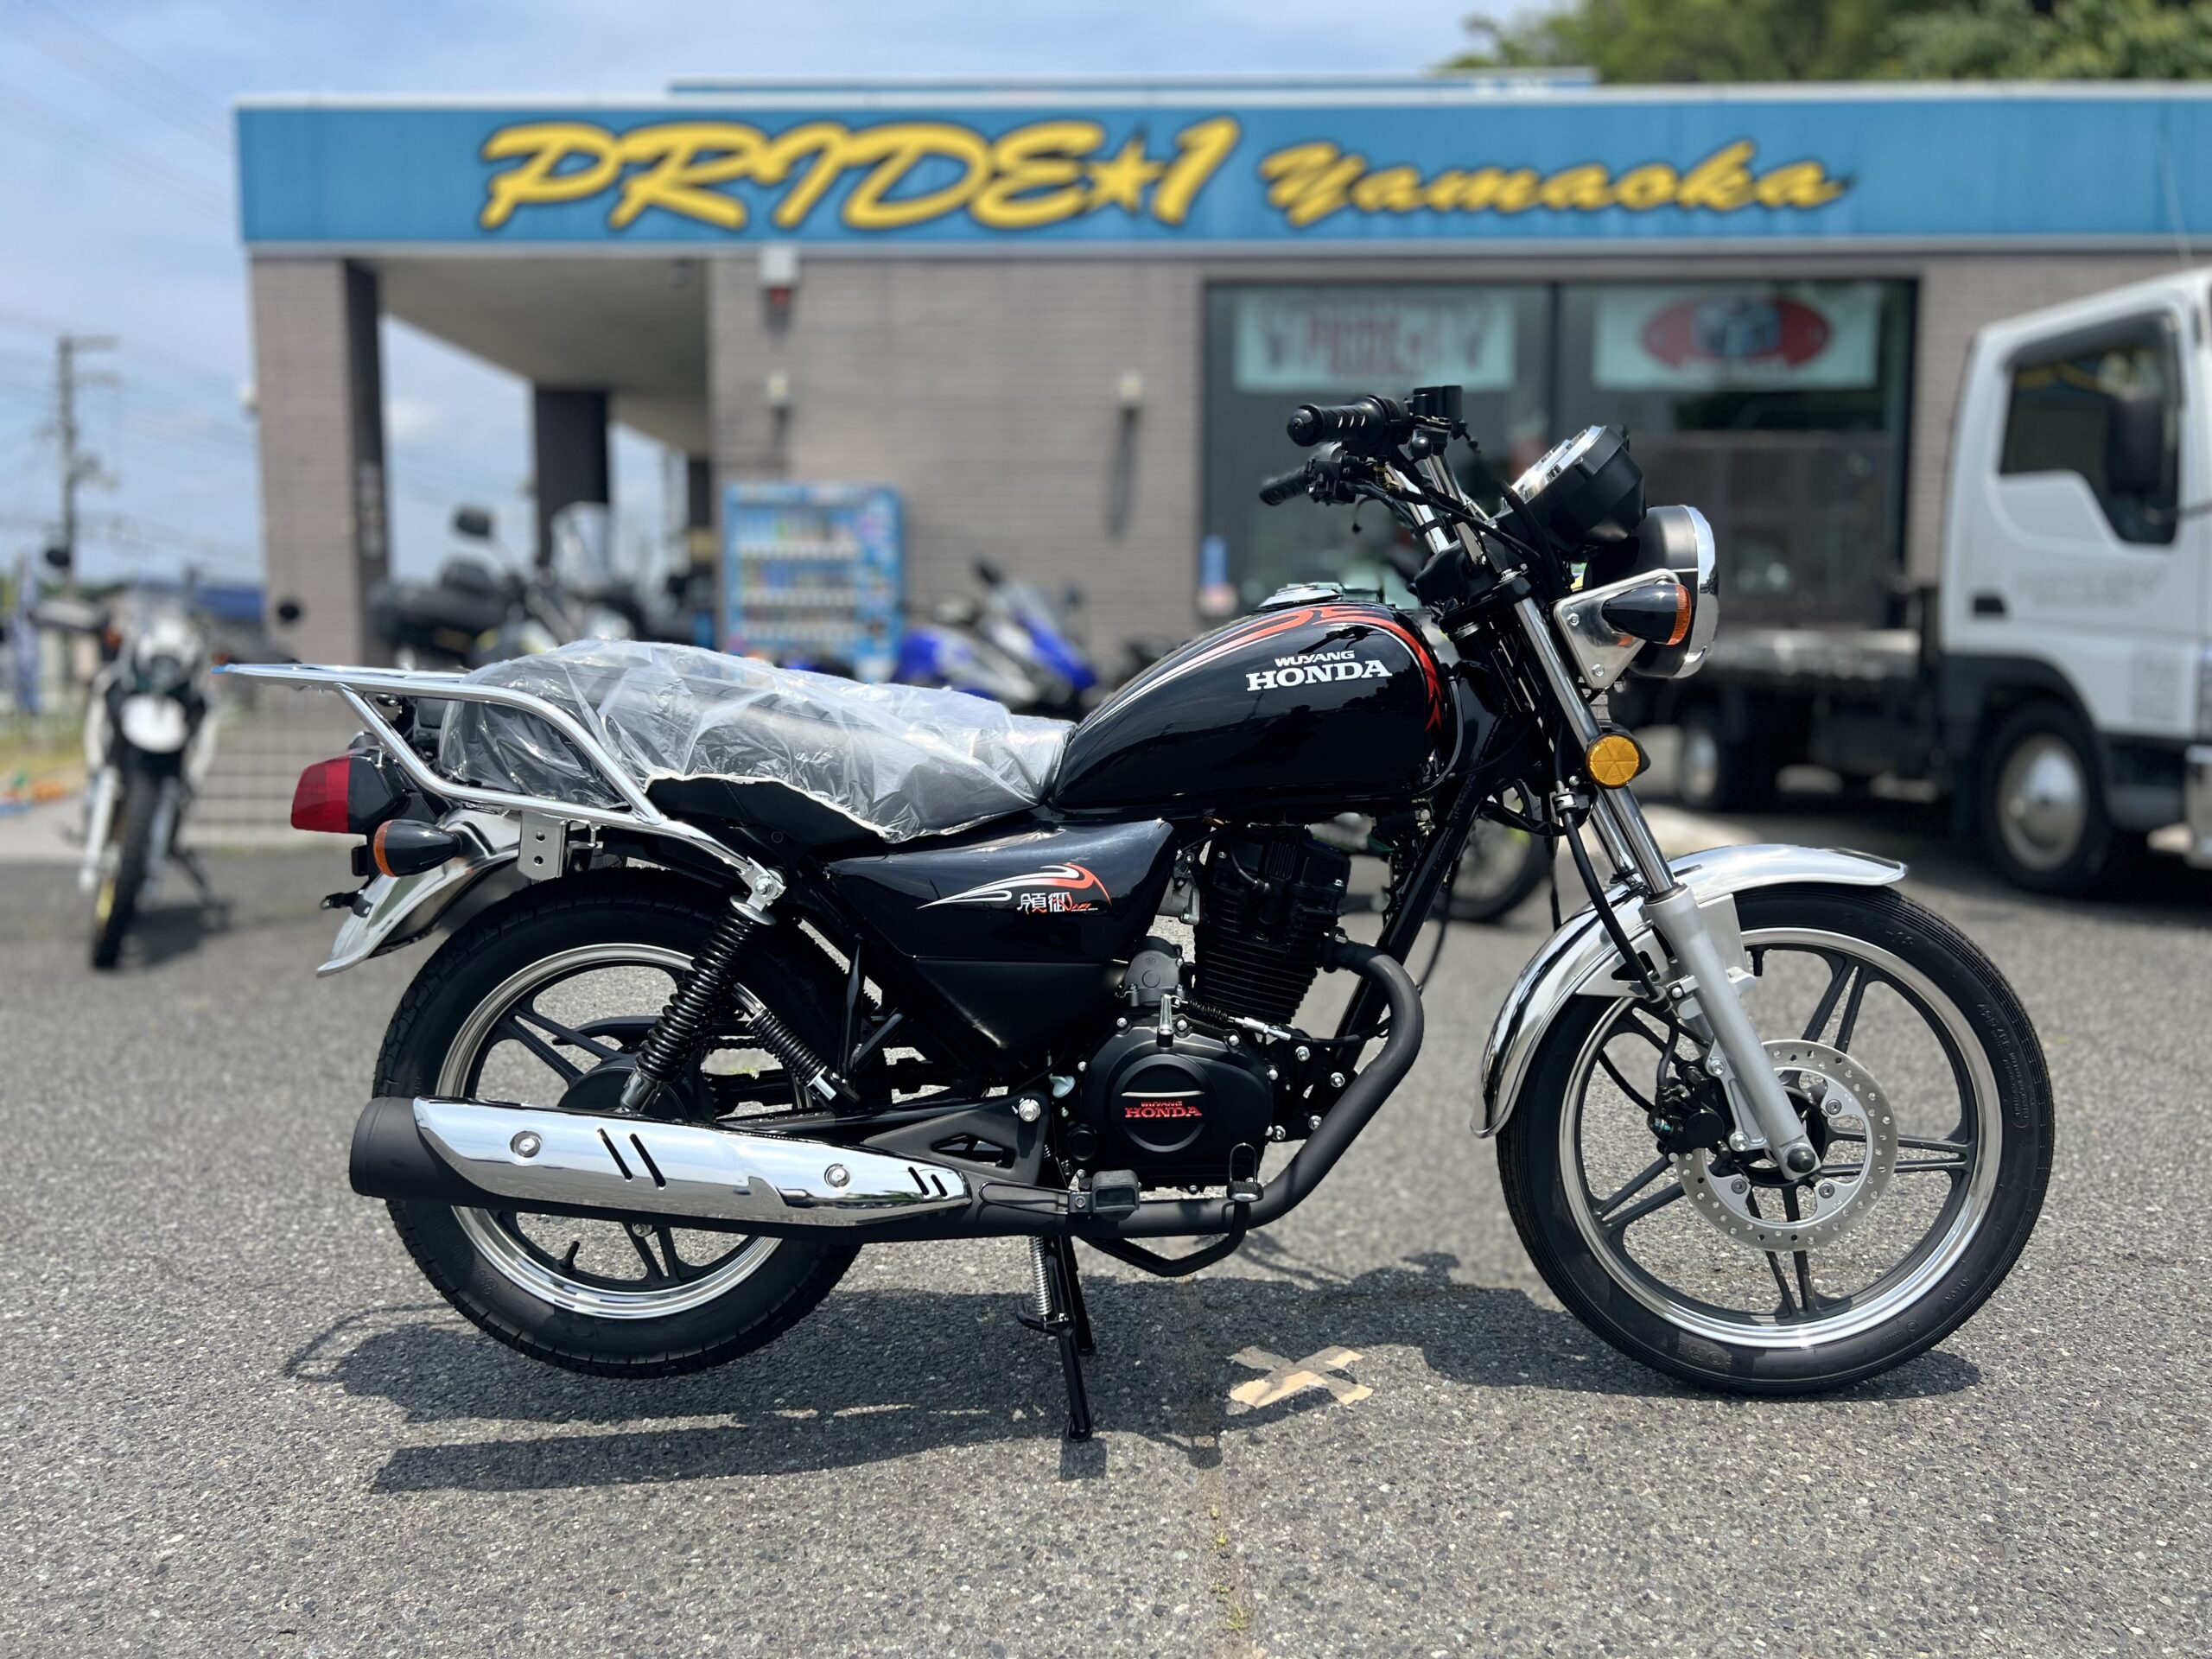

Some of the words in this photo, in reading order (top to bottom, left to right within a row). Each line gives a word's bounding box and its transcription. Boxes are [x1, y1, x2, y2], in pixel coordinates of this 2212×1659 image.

[1260, 140, 1847, 228] Yamaoka
[1274, 650, 1356, 667] WUYANG
[1245, 659, 1393, 691] HONDA
[1125, 1106, 1202, 1118] HONDA
